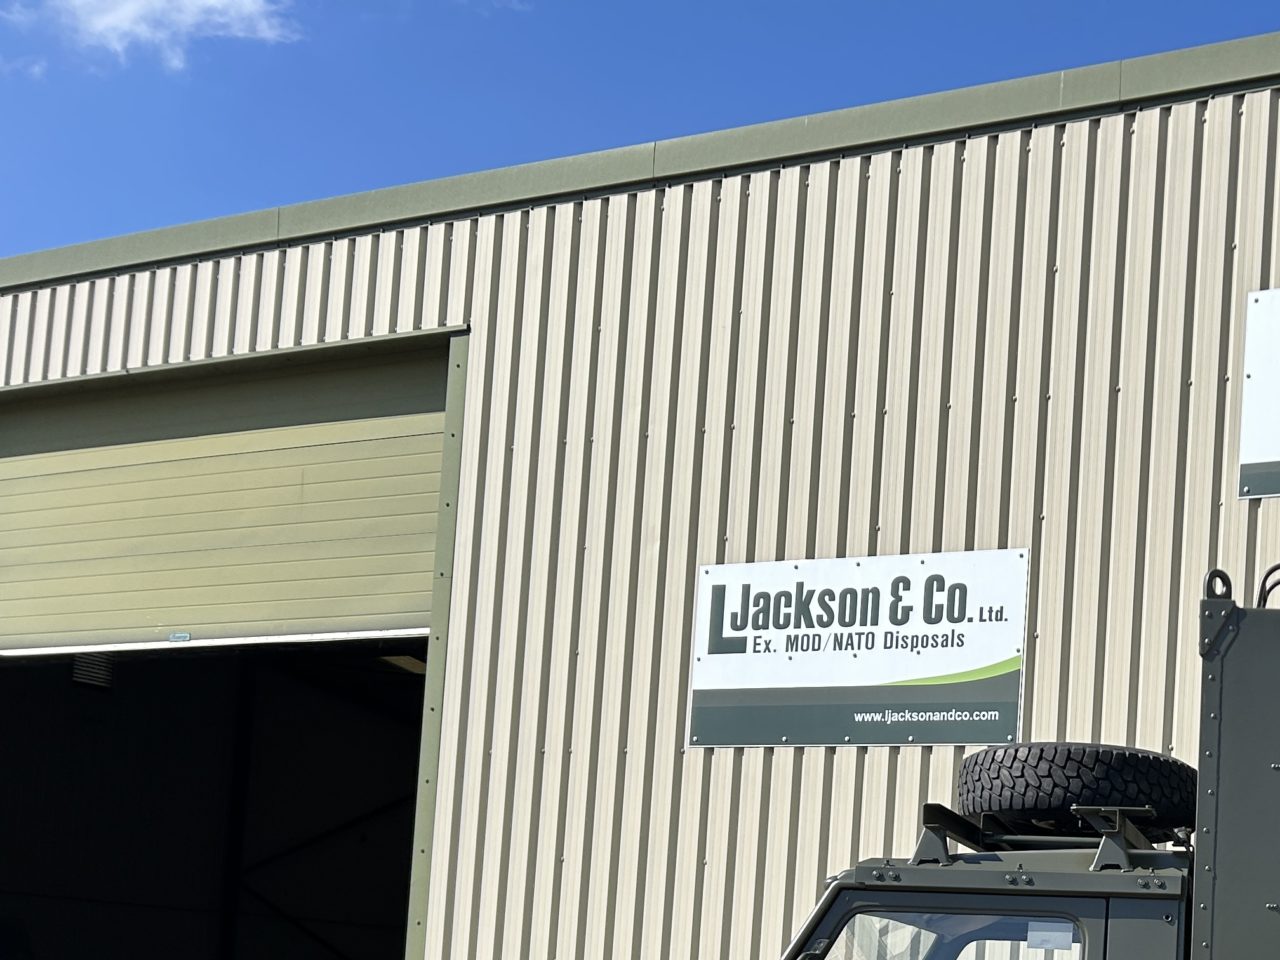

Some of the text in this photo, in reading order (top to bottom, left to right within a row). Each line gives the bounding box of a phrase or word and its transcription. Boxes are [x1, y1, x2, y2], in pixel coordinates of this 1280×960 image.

[888, 575, 914, 627] &
[922, 573, 975, 625] Co.
[978, 605, 1009, 623] Ltd.
[752, 628, 966, 654] Ex. MOD/NATO Disposals
[853, 708, 1001, 725] www.ljacksonandco.com
